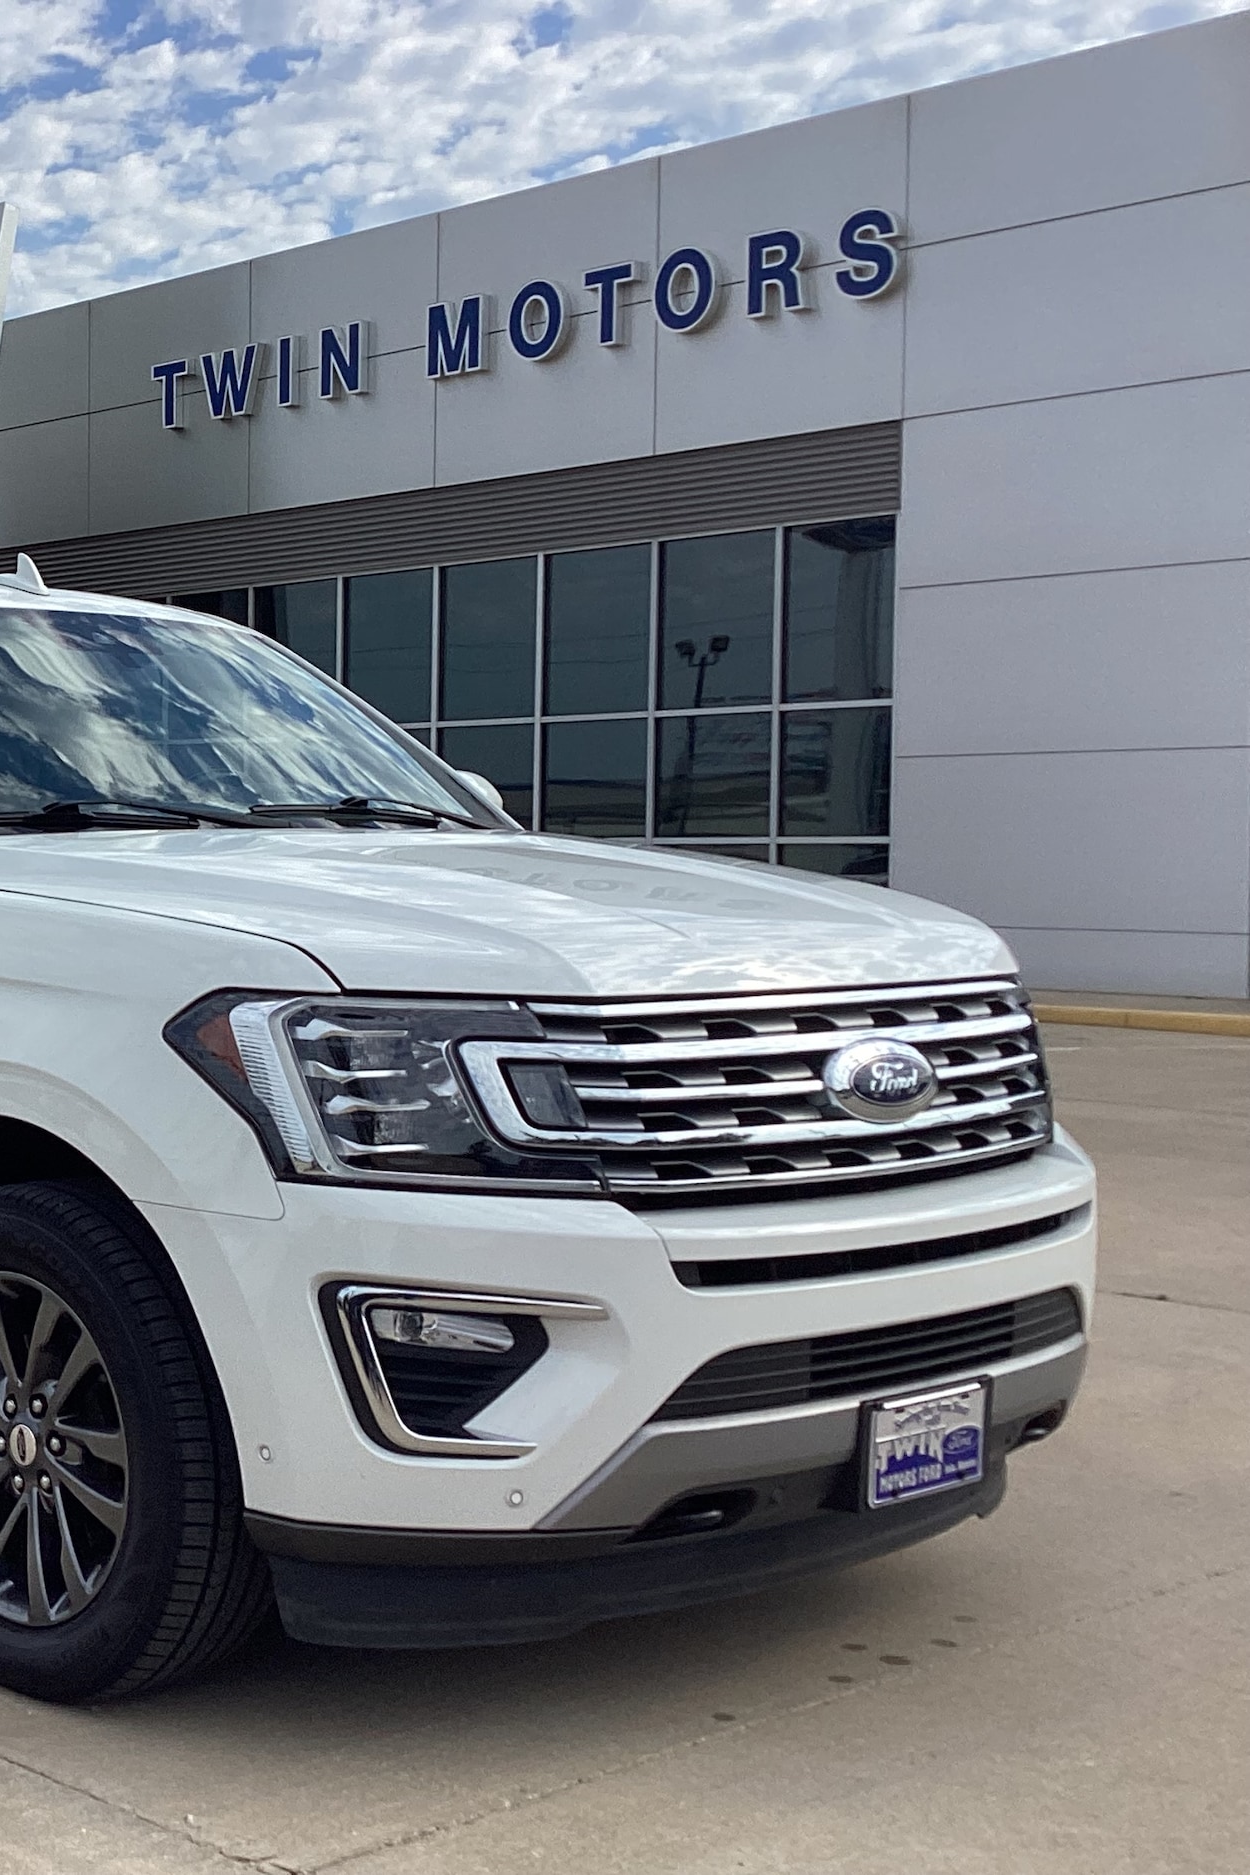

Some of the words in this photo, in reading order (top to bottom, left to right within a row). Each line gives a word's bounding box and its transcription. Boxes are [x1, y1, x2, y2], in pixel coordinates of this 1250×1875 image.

[152, 319, 370, 430] TWIN
[425, 207, 906, 379] MOTORS
[870, 1062, 919, 1093] Ford
